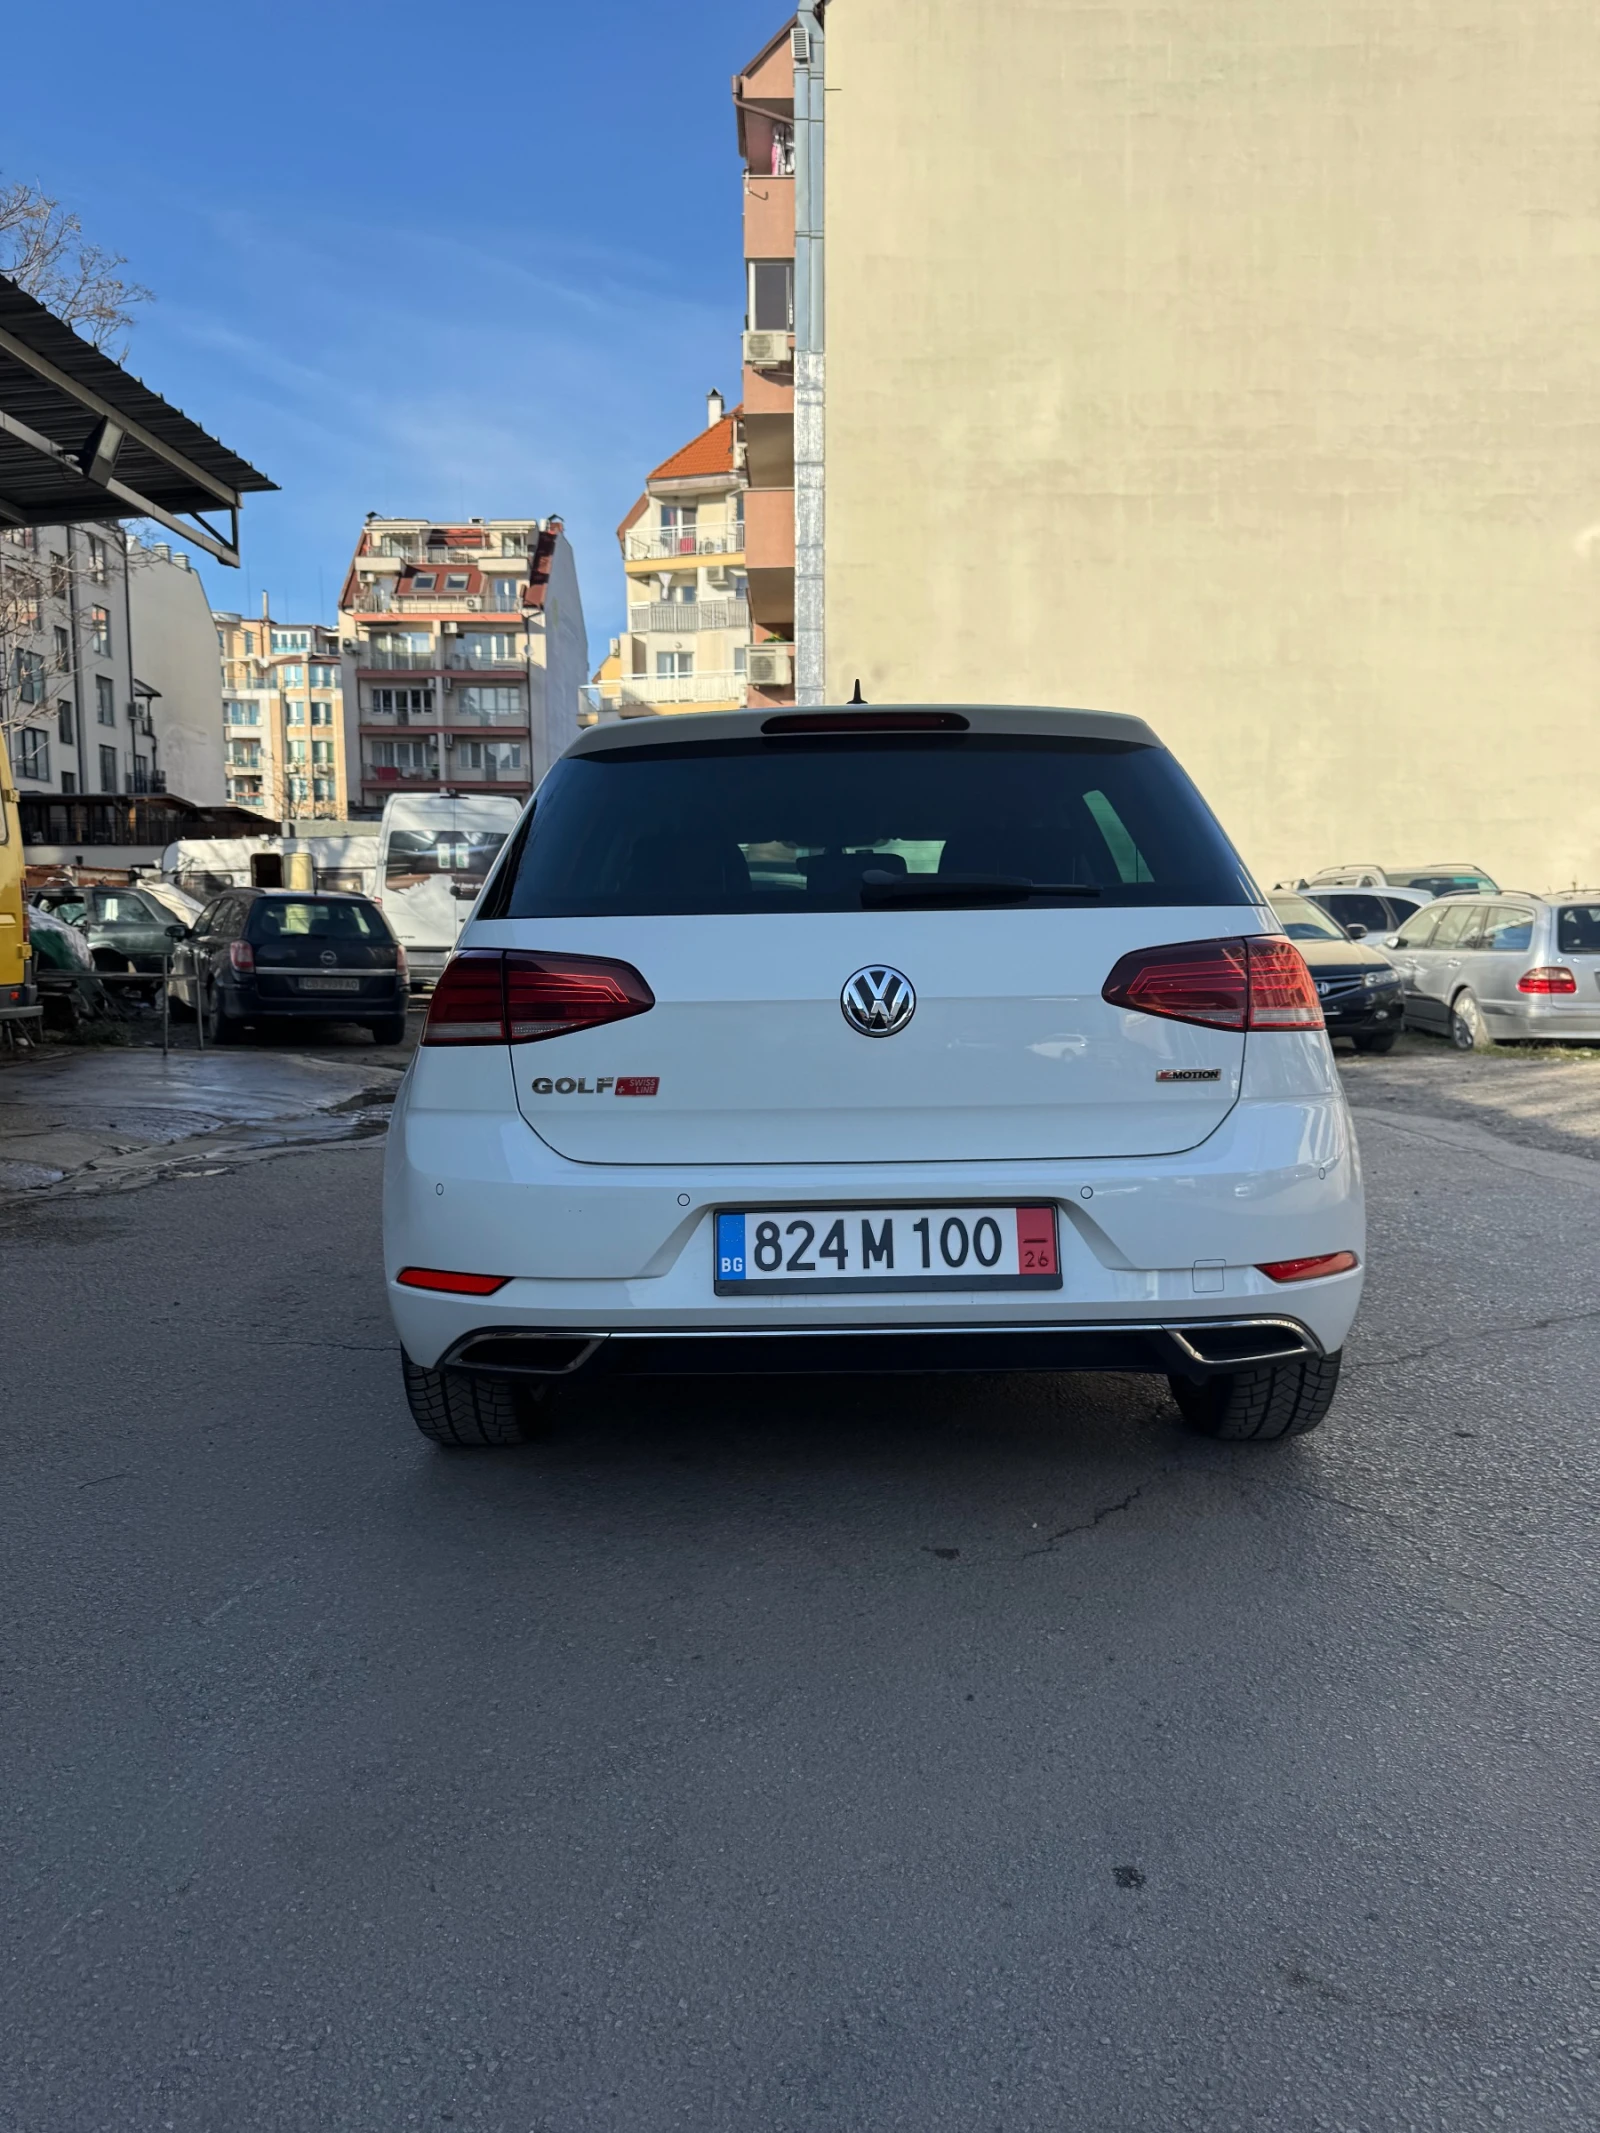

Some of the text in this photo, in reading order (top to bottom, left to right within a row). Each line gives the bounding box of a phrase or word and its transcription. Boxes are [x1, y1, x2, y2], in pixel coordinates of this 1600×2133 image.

[531, 1077, 614, 1094] GOLF
[635, 1086, 655, 1094] LINE
[754, 1216, 1003, 1272] 824 M 100
[721, 1257, 743, 1273] BG
[1024, 1250, 1049, 1268] 26
